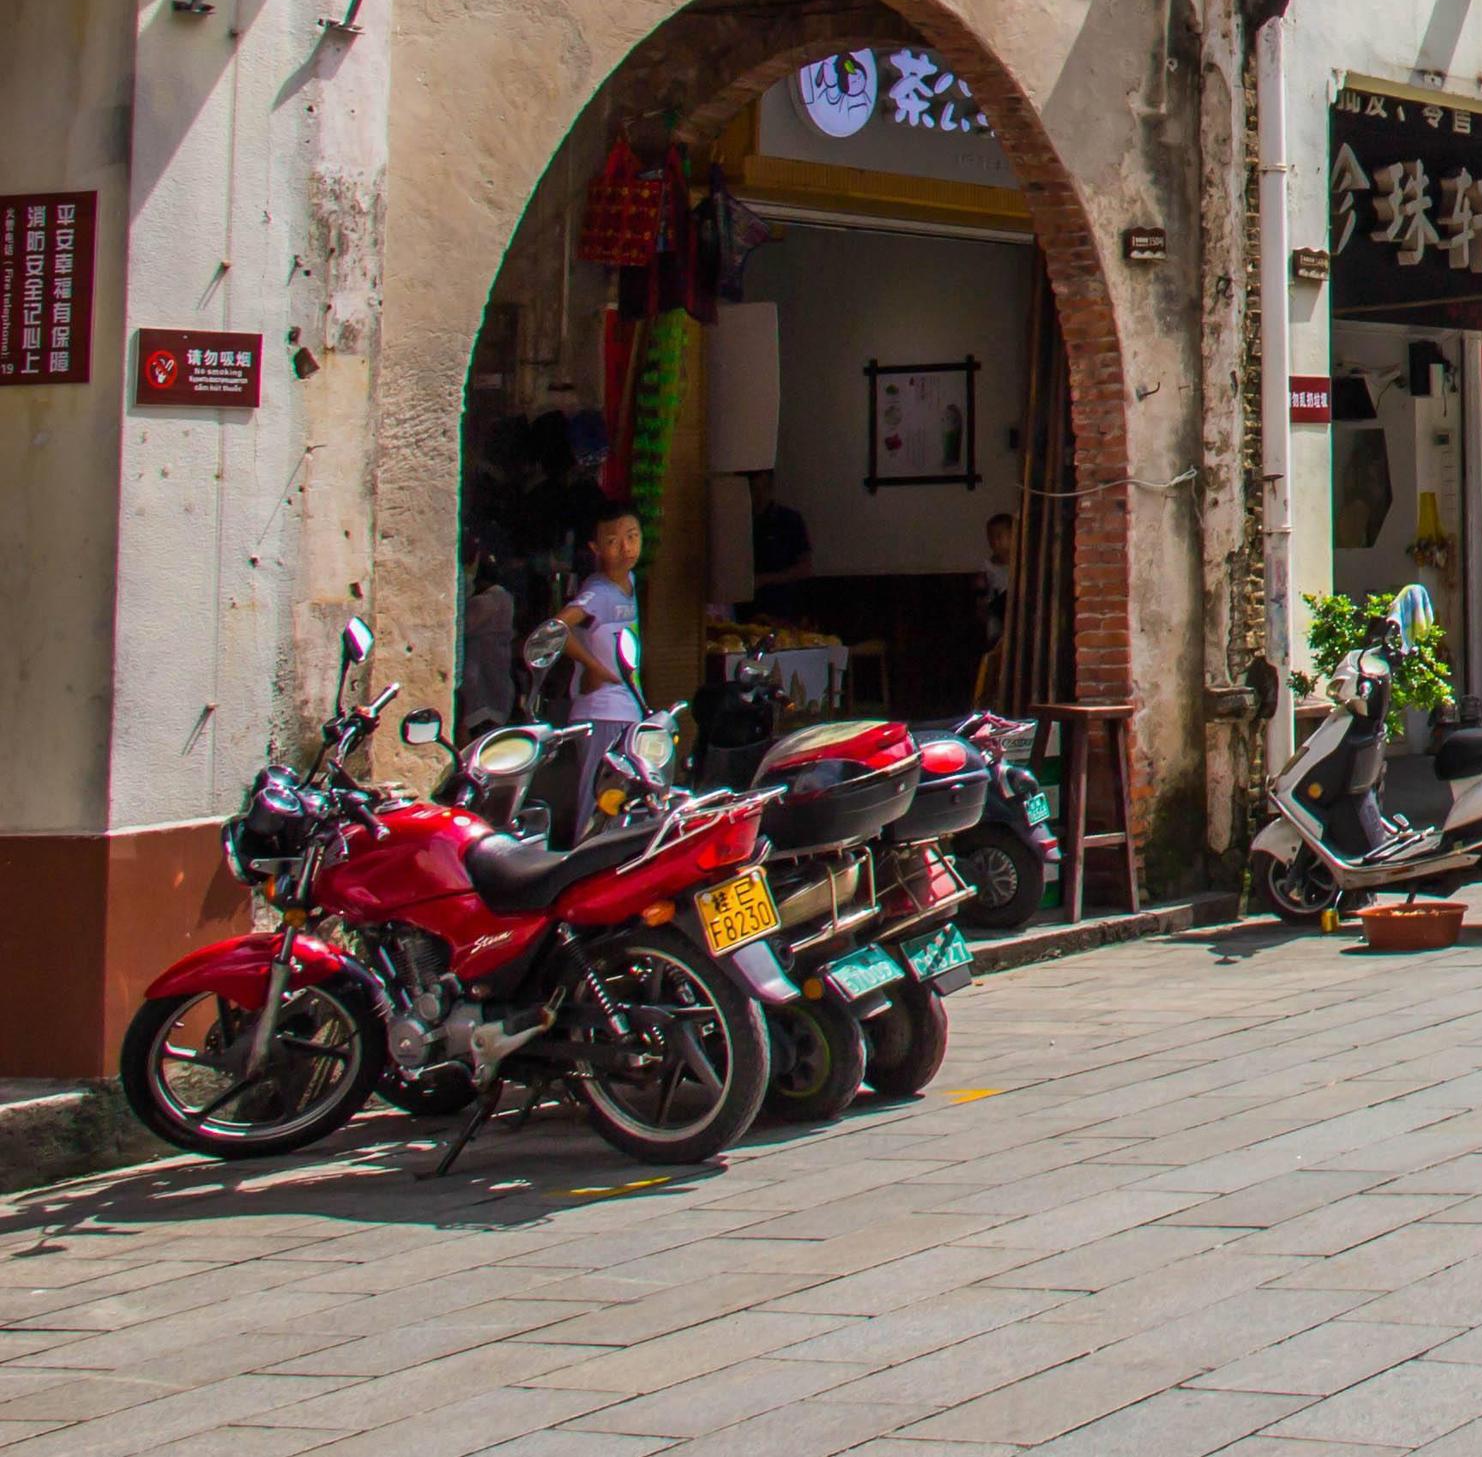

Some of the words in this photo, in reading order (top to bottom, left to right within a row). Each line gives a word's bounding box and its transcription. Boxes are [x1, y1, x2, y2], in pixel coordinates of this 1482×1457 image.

[889, 48, 996, 138] 茶公
[21, 205, 46, 374] 消防安全记心上
[50, 204, 76, 373] 平安幸福有保障
[187, 349, 252, 367] 请勿吸烟
[1289, 392, 1328, 409] 勿乱扔垃圾
[710, 901, 771, 948] F8230
